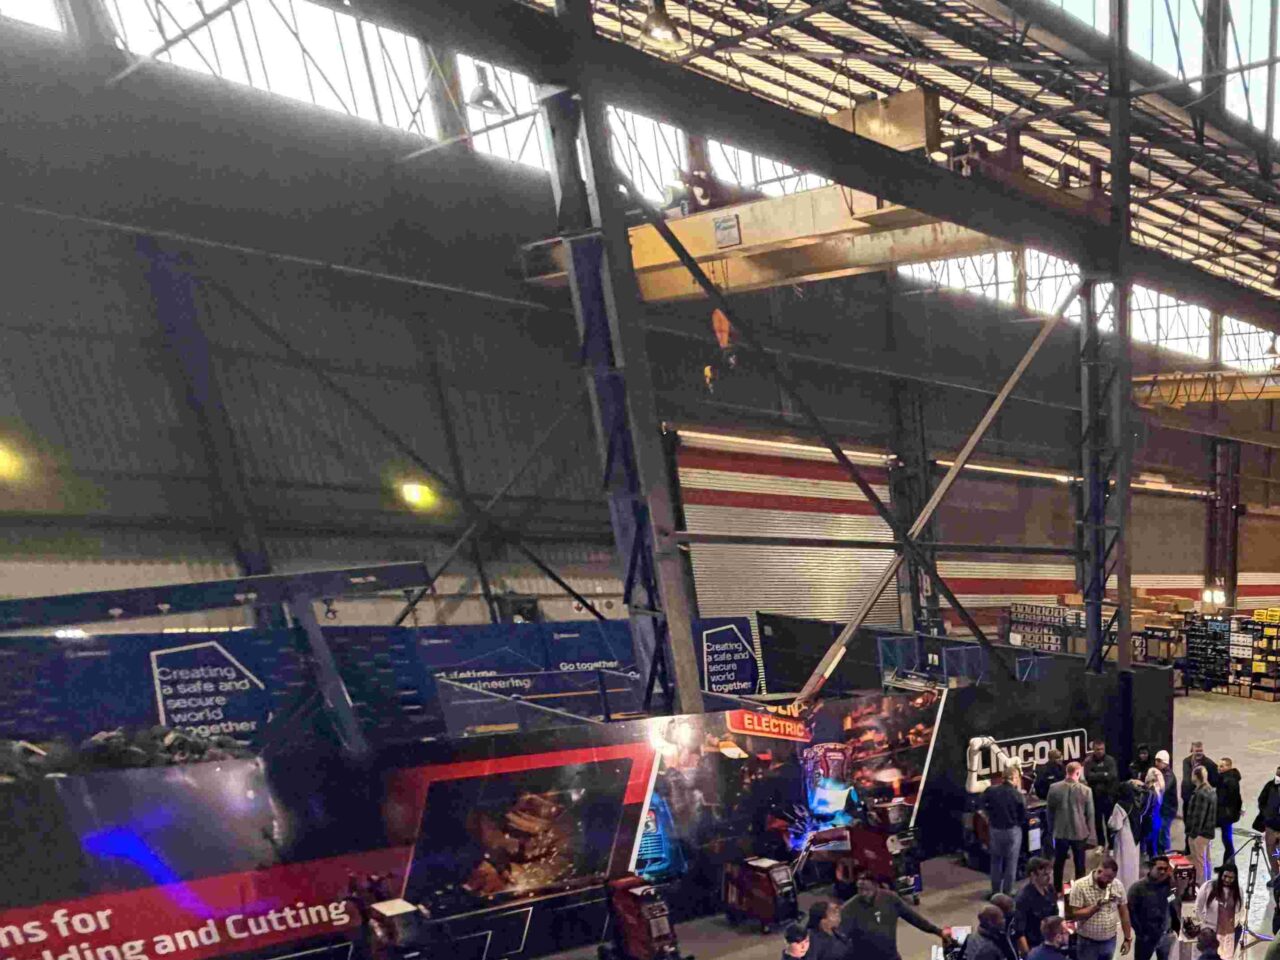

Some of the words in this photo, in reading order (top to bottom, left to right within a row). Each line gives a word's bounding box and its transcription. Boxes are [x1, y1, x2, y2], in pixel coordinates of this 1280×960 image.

[705, 642, 743, 653] Creating
[713, 652, 733, 662] safe
[733, 650, 750, 660] and
[157, 665, 237, 680] Creating
[708, 662, 738, 672] secure
[710, 672, 736, 682] world
[162, 686, 174, 696] a
[176, 681, 215, 694] safe
[218, 679, 251, 692] and
[711, 681, 753, 693] together
[165, 696, 227, 709] secure
[170, 708, 224, 723] world
[744, 713, 805, 737] ELECTRIC
[51, 907, 114, 938] for
[153, 918, 224, 955] and
[225, 899, 350, 938] Cutting
